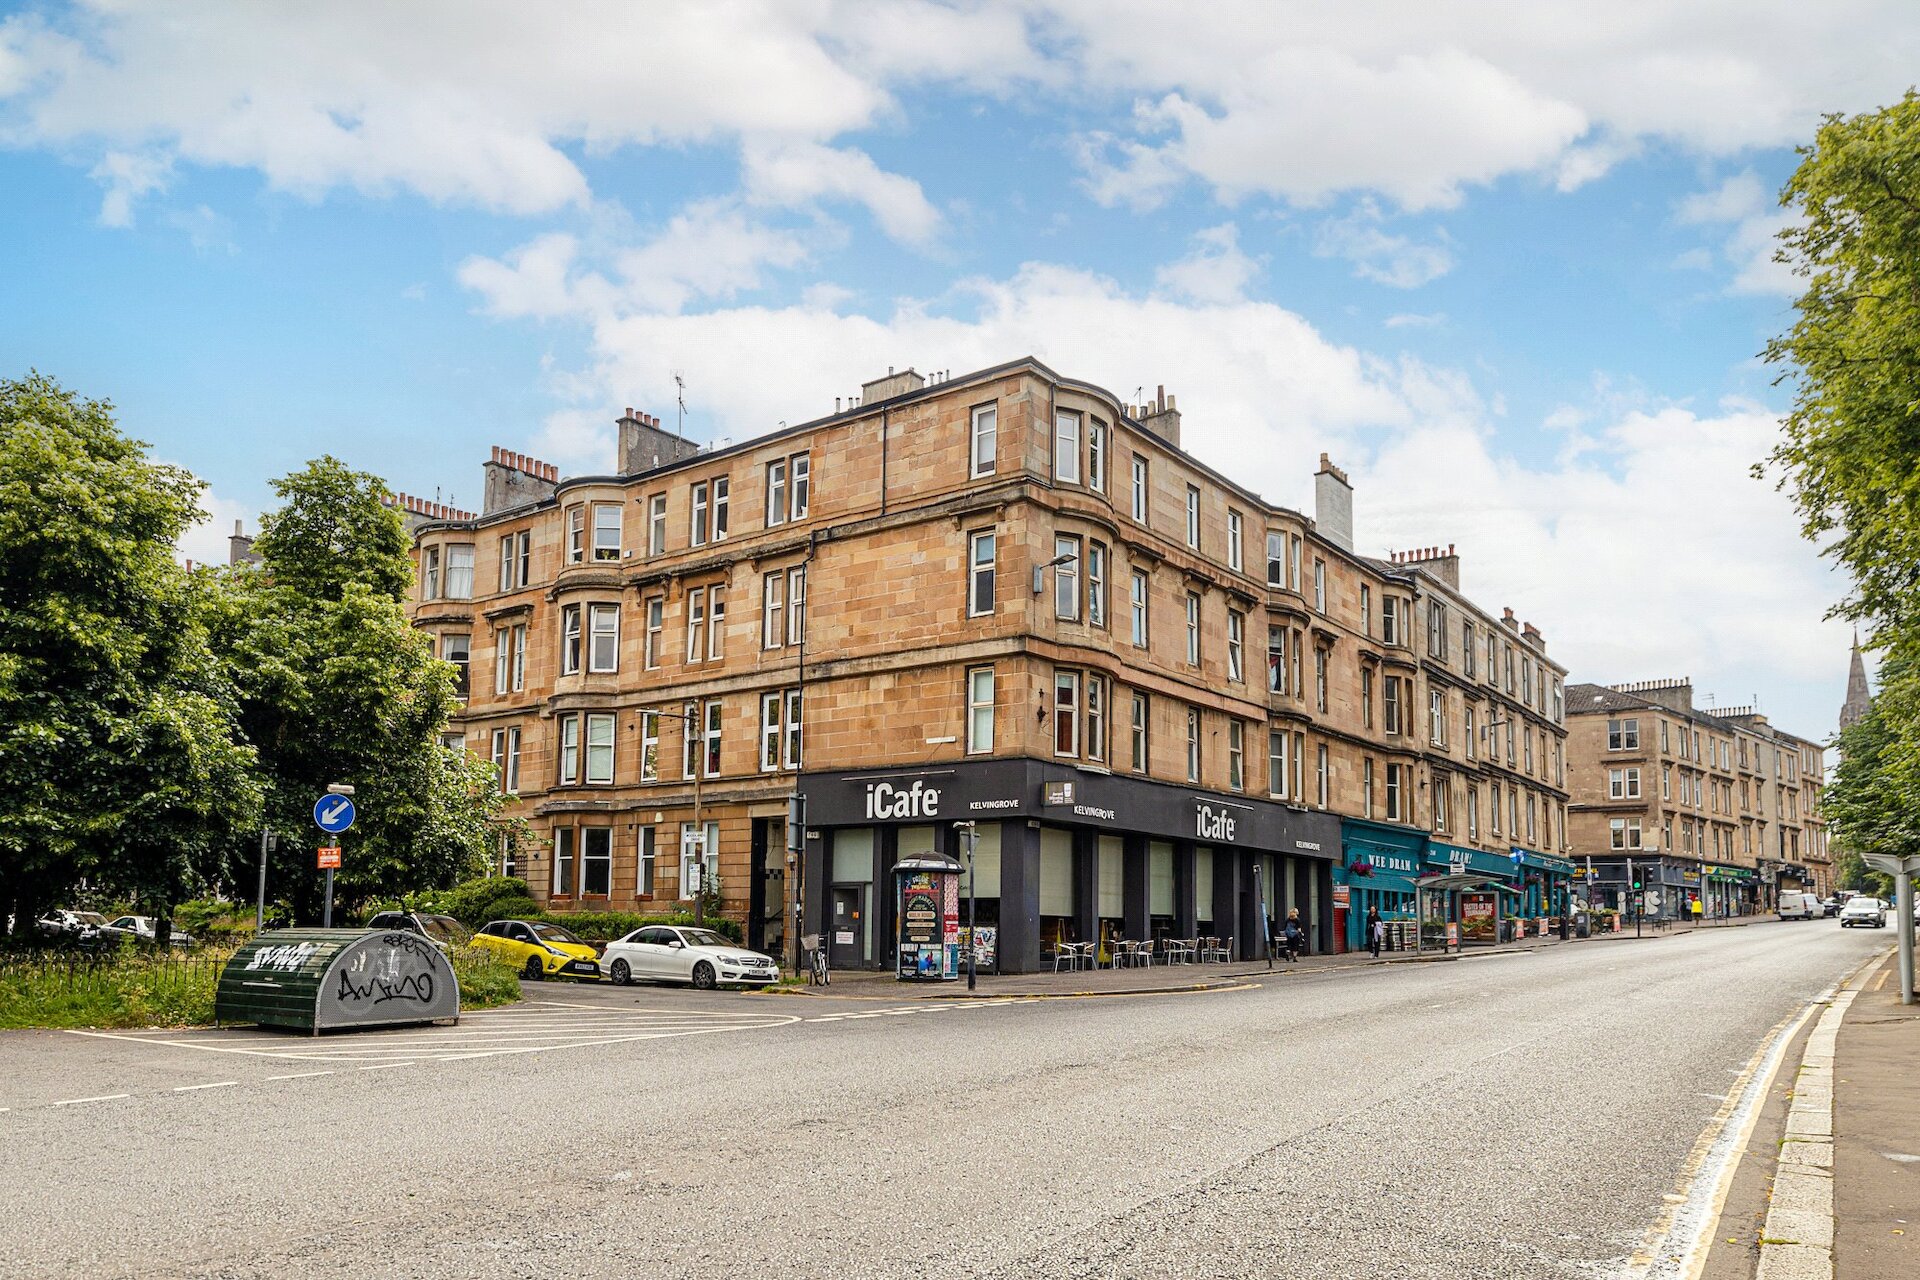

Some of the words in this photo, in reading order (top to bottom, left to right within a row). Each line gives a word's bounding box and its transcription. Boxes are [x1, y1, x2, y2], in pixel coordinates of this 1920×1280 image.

[866, 780, 938, 819] iCafe
[970, 800, 1019, 810] KELVINGROVE
[1074, 804, 1115, 820] KELVINGROVE
[1196, 804, 1235, 841] iCafe
[1368, 854, 1386, 868] WEE
[1389, 857, 1411, 871] DRAM
